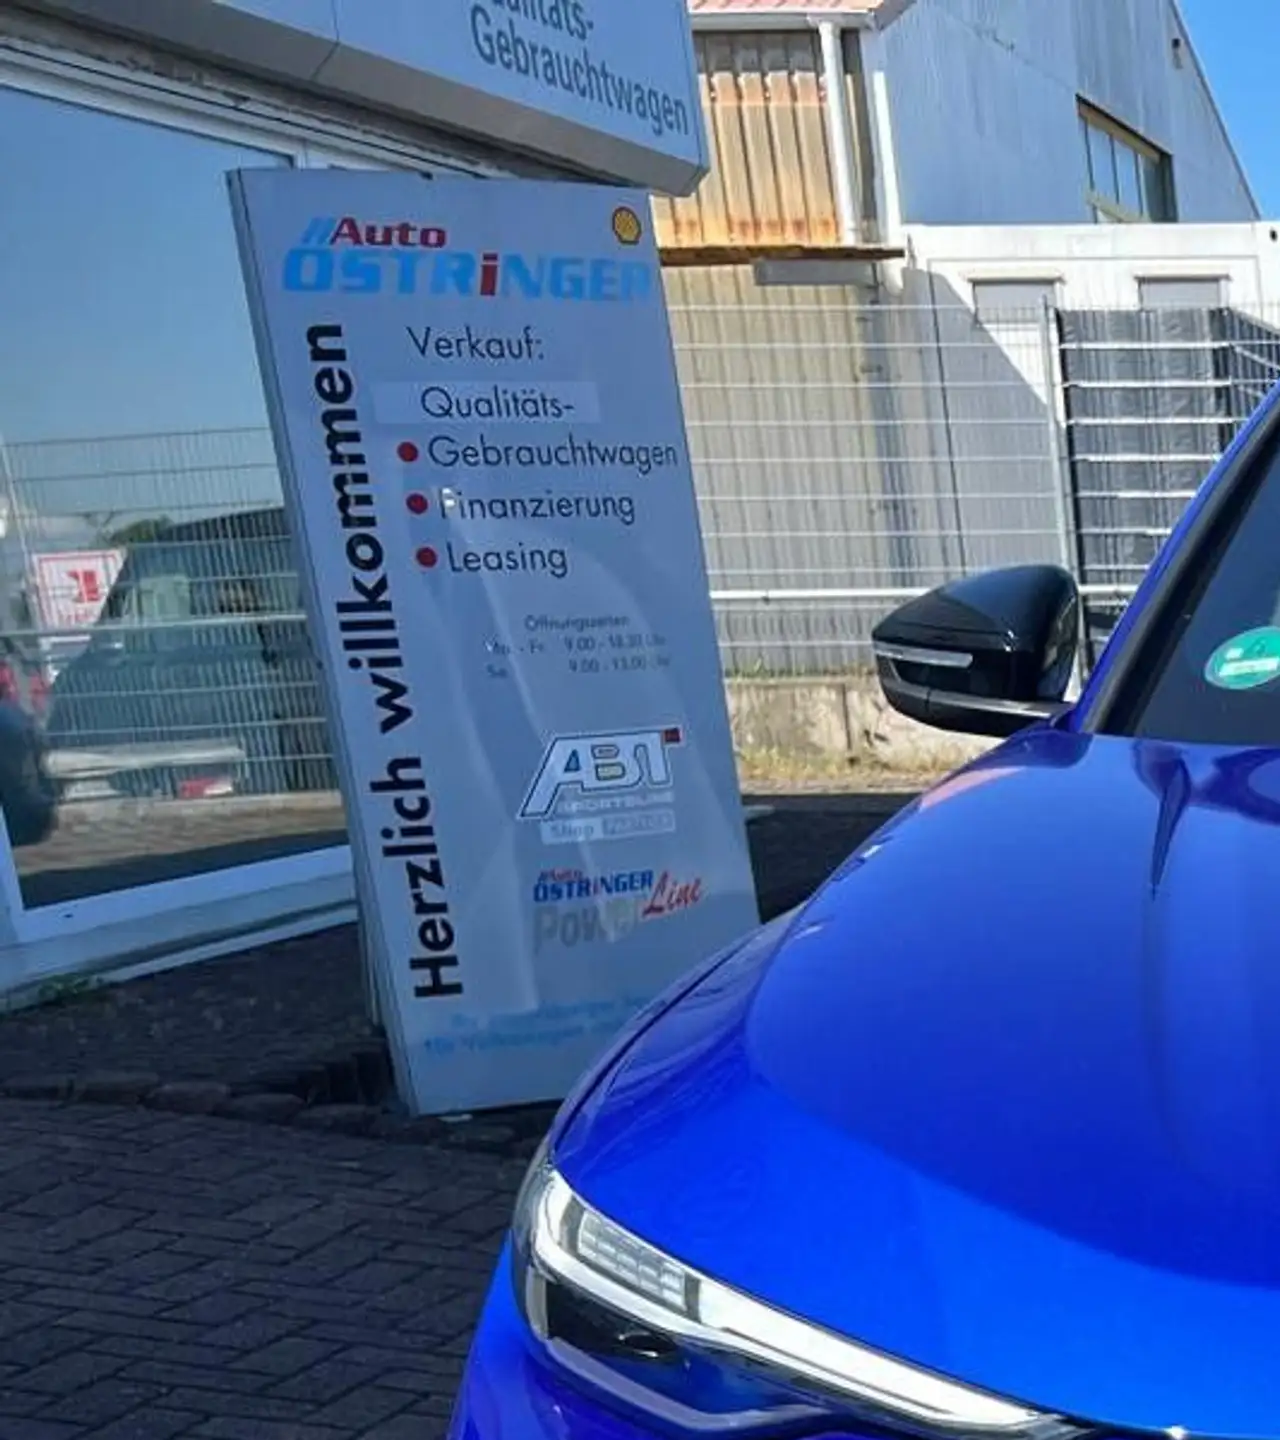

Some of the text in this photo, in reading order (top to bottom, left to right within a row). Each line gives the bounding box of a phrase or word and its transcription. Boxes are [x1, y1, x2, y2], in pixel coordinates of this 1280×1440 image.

[471, 4, 689, 136] Gebrauchtwagen
[329, 217, 447, 248] Auto
[406, 324, 545, 360] Verkauf:
[421, 385, 575, 418] Qualitäts-
[428, 433, 678, 475] Gebrauchtwagen
[440, 488, 635, 525] Finanzierung
[446, 541, 567, 579] Leasing
[307, 324, 463, 998] Herzlich willkommen
[518, 727, 681, 819] ABT
